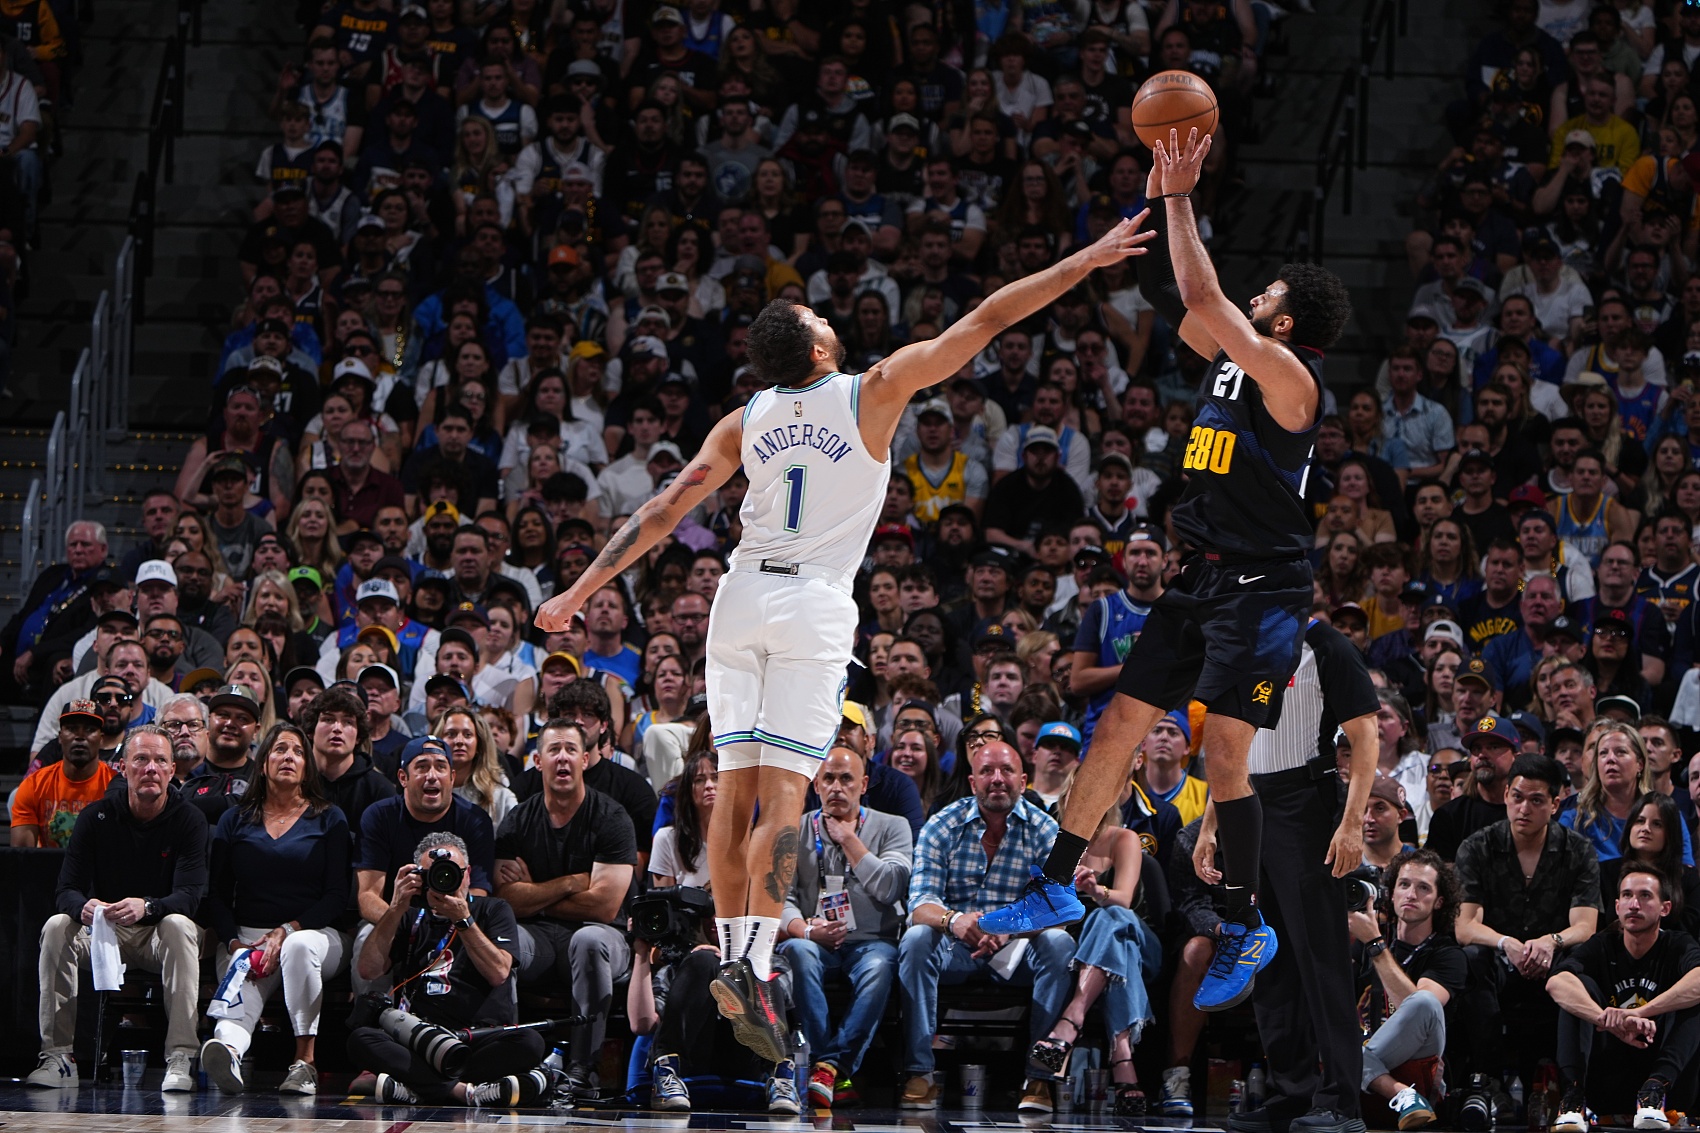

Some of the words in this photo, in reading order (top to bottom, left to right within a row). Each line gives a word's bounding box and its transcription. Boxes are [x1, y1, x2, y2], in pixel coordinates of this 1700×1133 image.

[753, 424, 853, 464] ANDERSON
[1183, 425, 1238, 475] 280
[783, 464, 808, 534] 1
[1469, 615, 1518, 643] NUGGET
